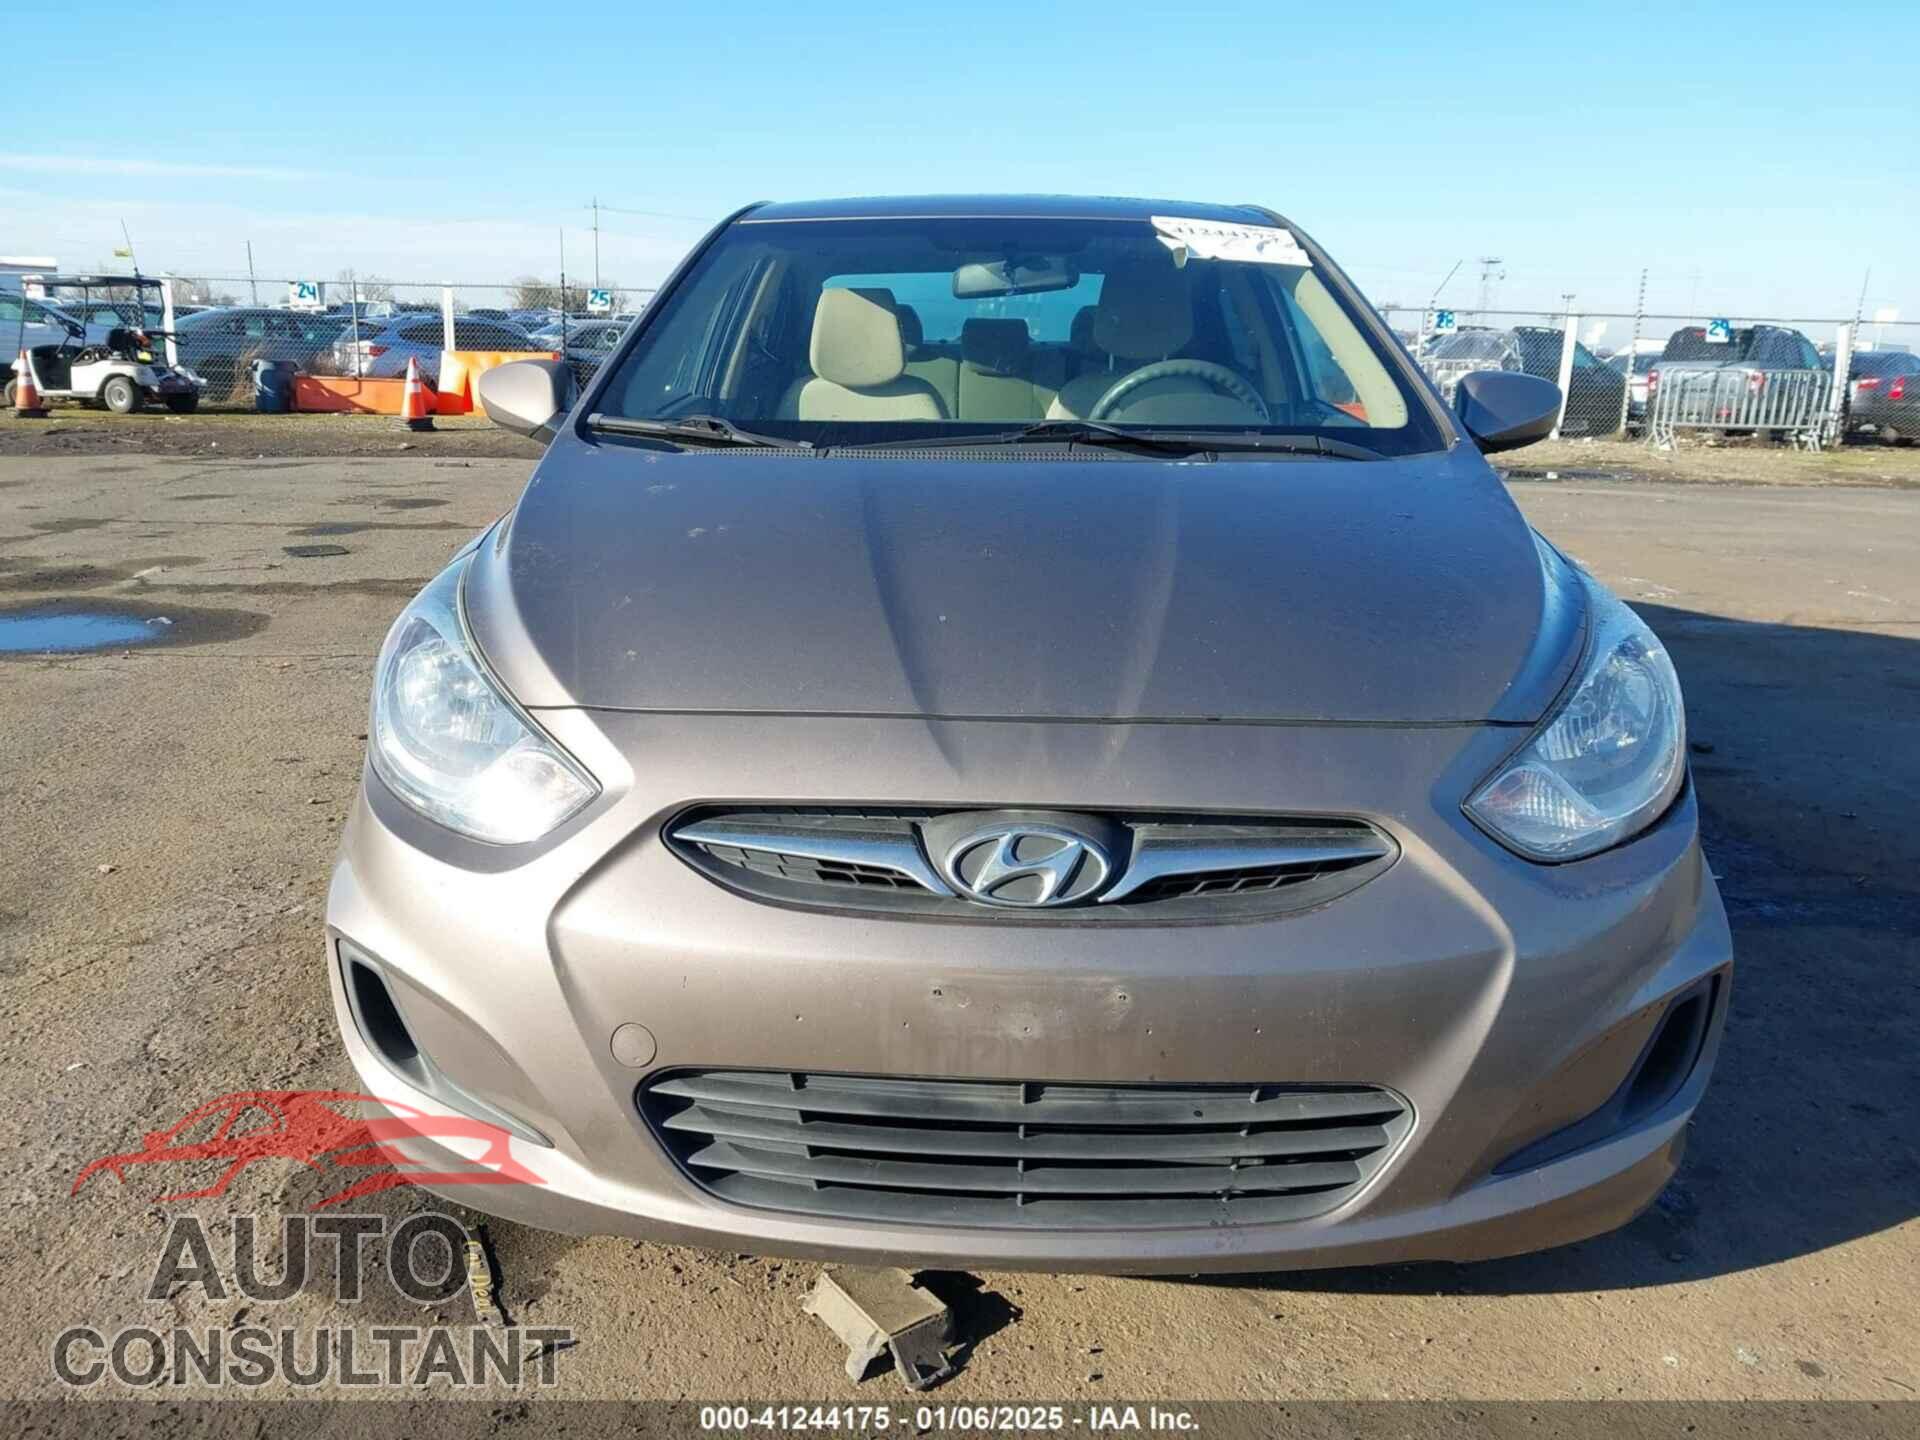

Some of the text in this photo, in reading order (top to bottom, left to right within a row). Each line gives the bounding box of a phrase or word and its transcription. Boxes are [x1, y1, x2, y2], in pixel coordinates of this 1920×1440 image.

[297, 282, 317, 302] 24
[590, 288, 609, 307] 25
[1709, 319, 1730, 339] 29
